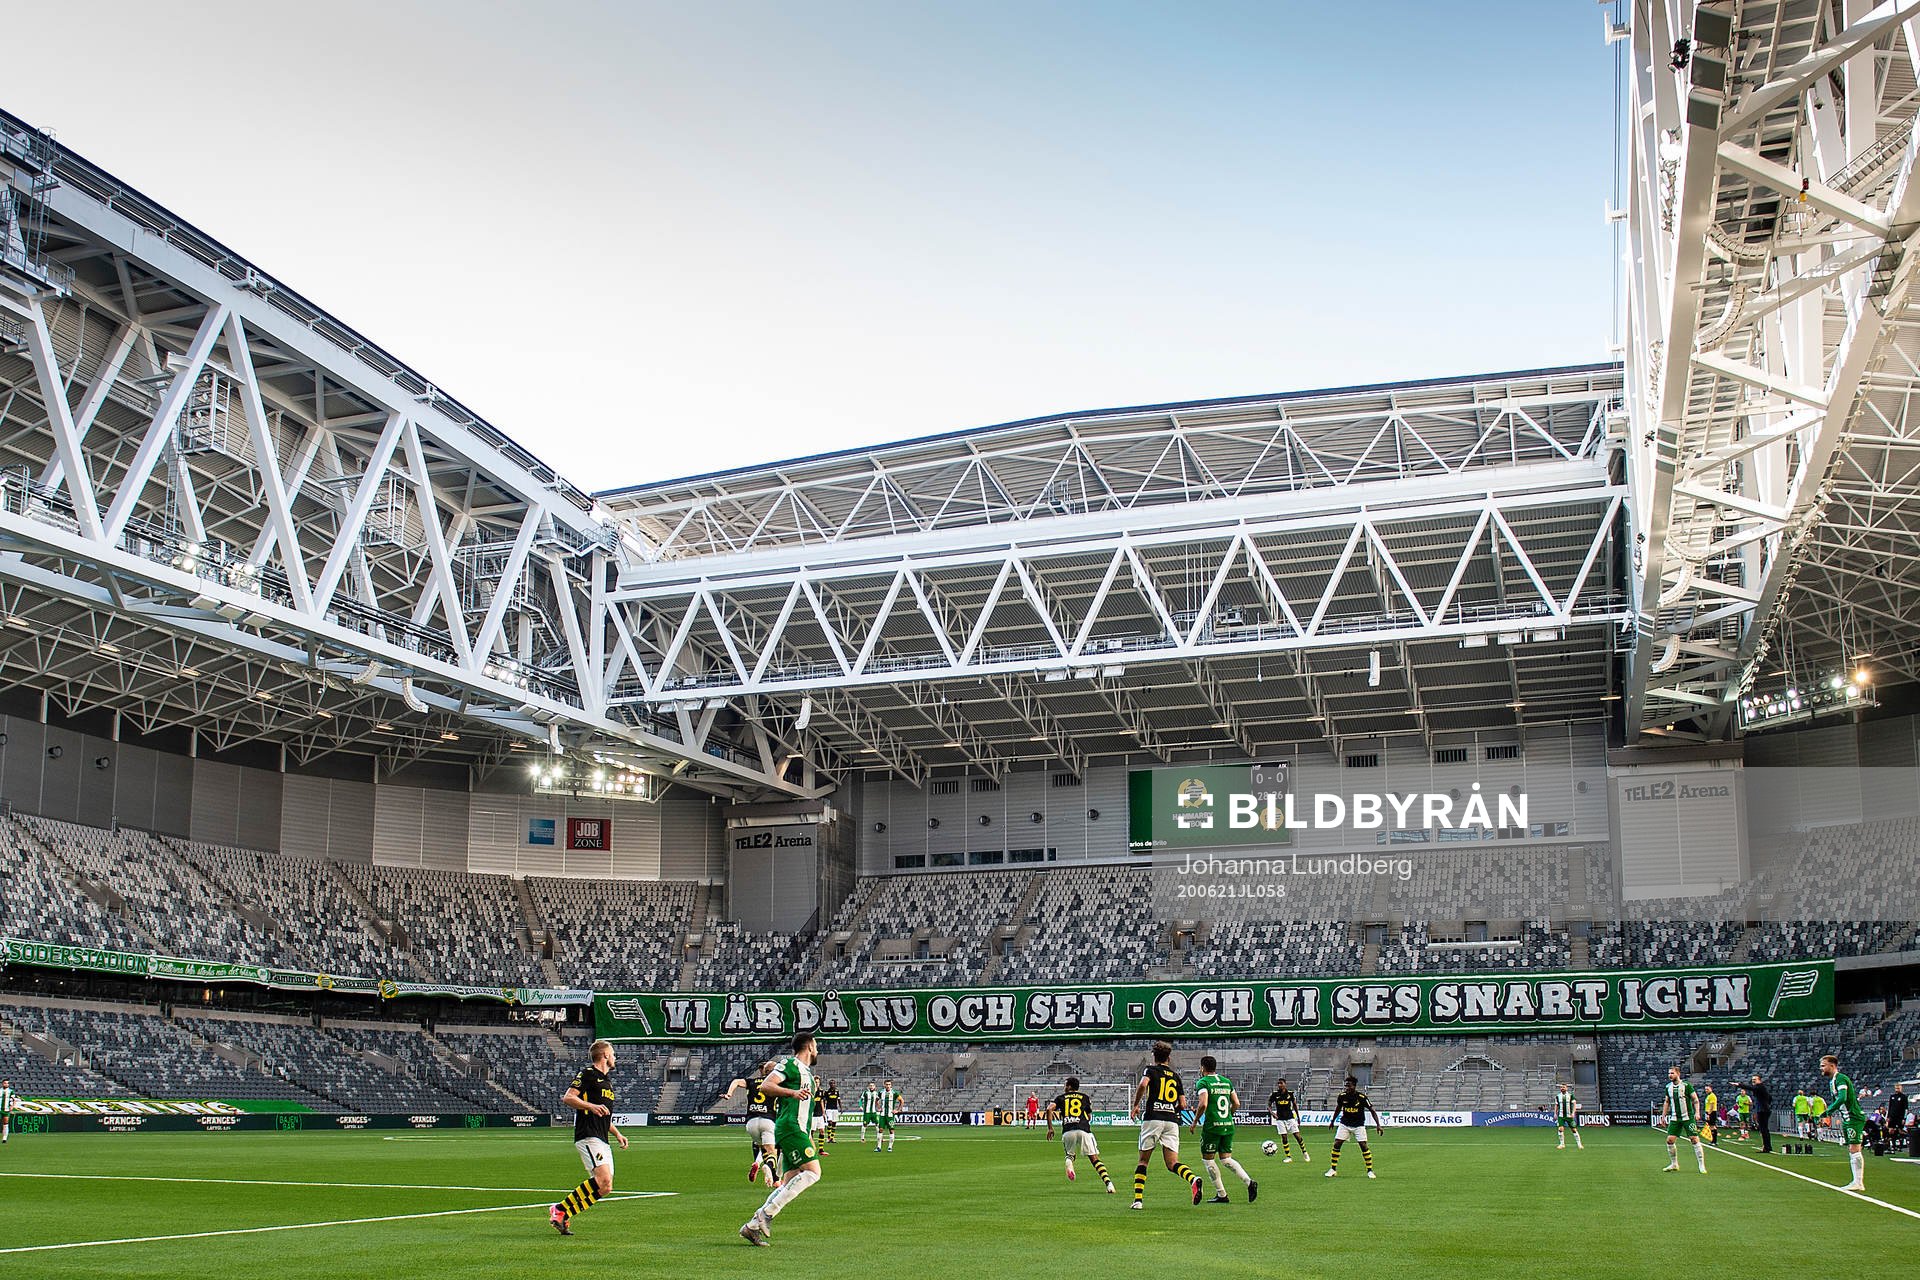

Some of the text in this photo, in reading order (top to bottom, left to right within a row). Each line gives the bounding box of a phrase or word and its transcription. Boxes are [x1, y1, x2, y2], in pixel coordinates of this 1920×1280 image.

[1256, 774, 1264, 784] 0
[1276, 772, 1284, 782] 0
[1625, 780, 1730, 802] TELE2 Arena
[577, 822, 599, 837] JOB
[574, 838, 603, 848] ZONE
[735, 832, 812, 850] TELE2 Arena
[663, 1000, 708, 1033] VI
[722, 994, 782, 1033] ÄR
[794, 991, 848, 1033] DÅ
[857, 997, 916, 1032] NU
[928, 994, 1014, 1032] OCH
[1026, 992, 1113, 1030] SEN
[1154, 989, 1253, 1027] OCH
[1266, 988, 1319, 1026] VI
[1333, 985, 1420, 1024] SES
[1431, 981, 1608, 1022] SNART
[1619, 975, 1750, 1020] IGEN
[754, 1085, 766, 1104] 3
[1158, 1077, 1178, 1102] 16
[750, 1104, 768, 1112] SVEA
[1064, 1098, 1082, 1117] 18
[1153, 1102, 1175, 1110] SVEA
[1217, 1096, 1229, 1118] 9
[18, 1116, 44, 1125] BAJEN
[894, 1112, 962, 1124] METODGOLV
[1392, 1114, 1462, 1124] TEKNOS FÄRG
[1485, 1112, 1538, 1126] JOHANNESHOVS
[1540, 1112, 1554, 1123] RÖR
[1579, 1114, 1610, 1126] DICKENS
[22, 1124, 40, 1134] BAR
